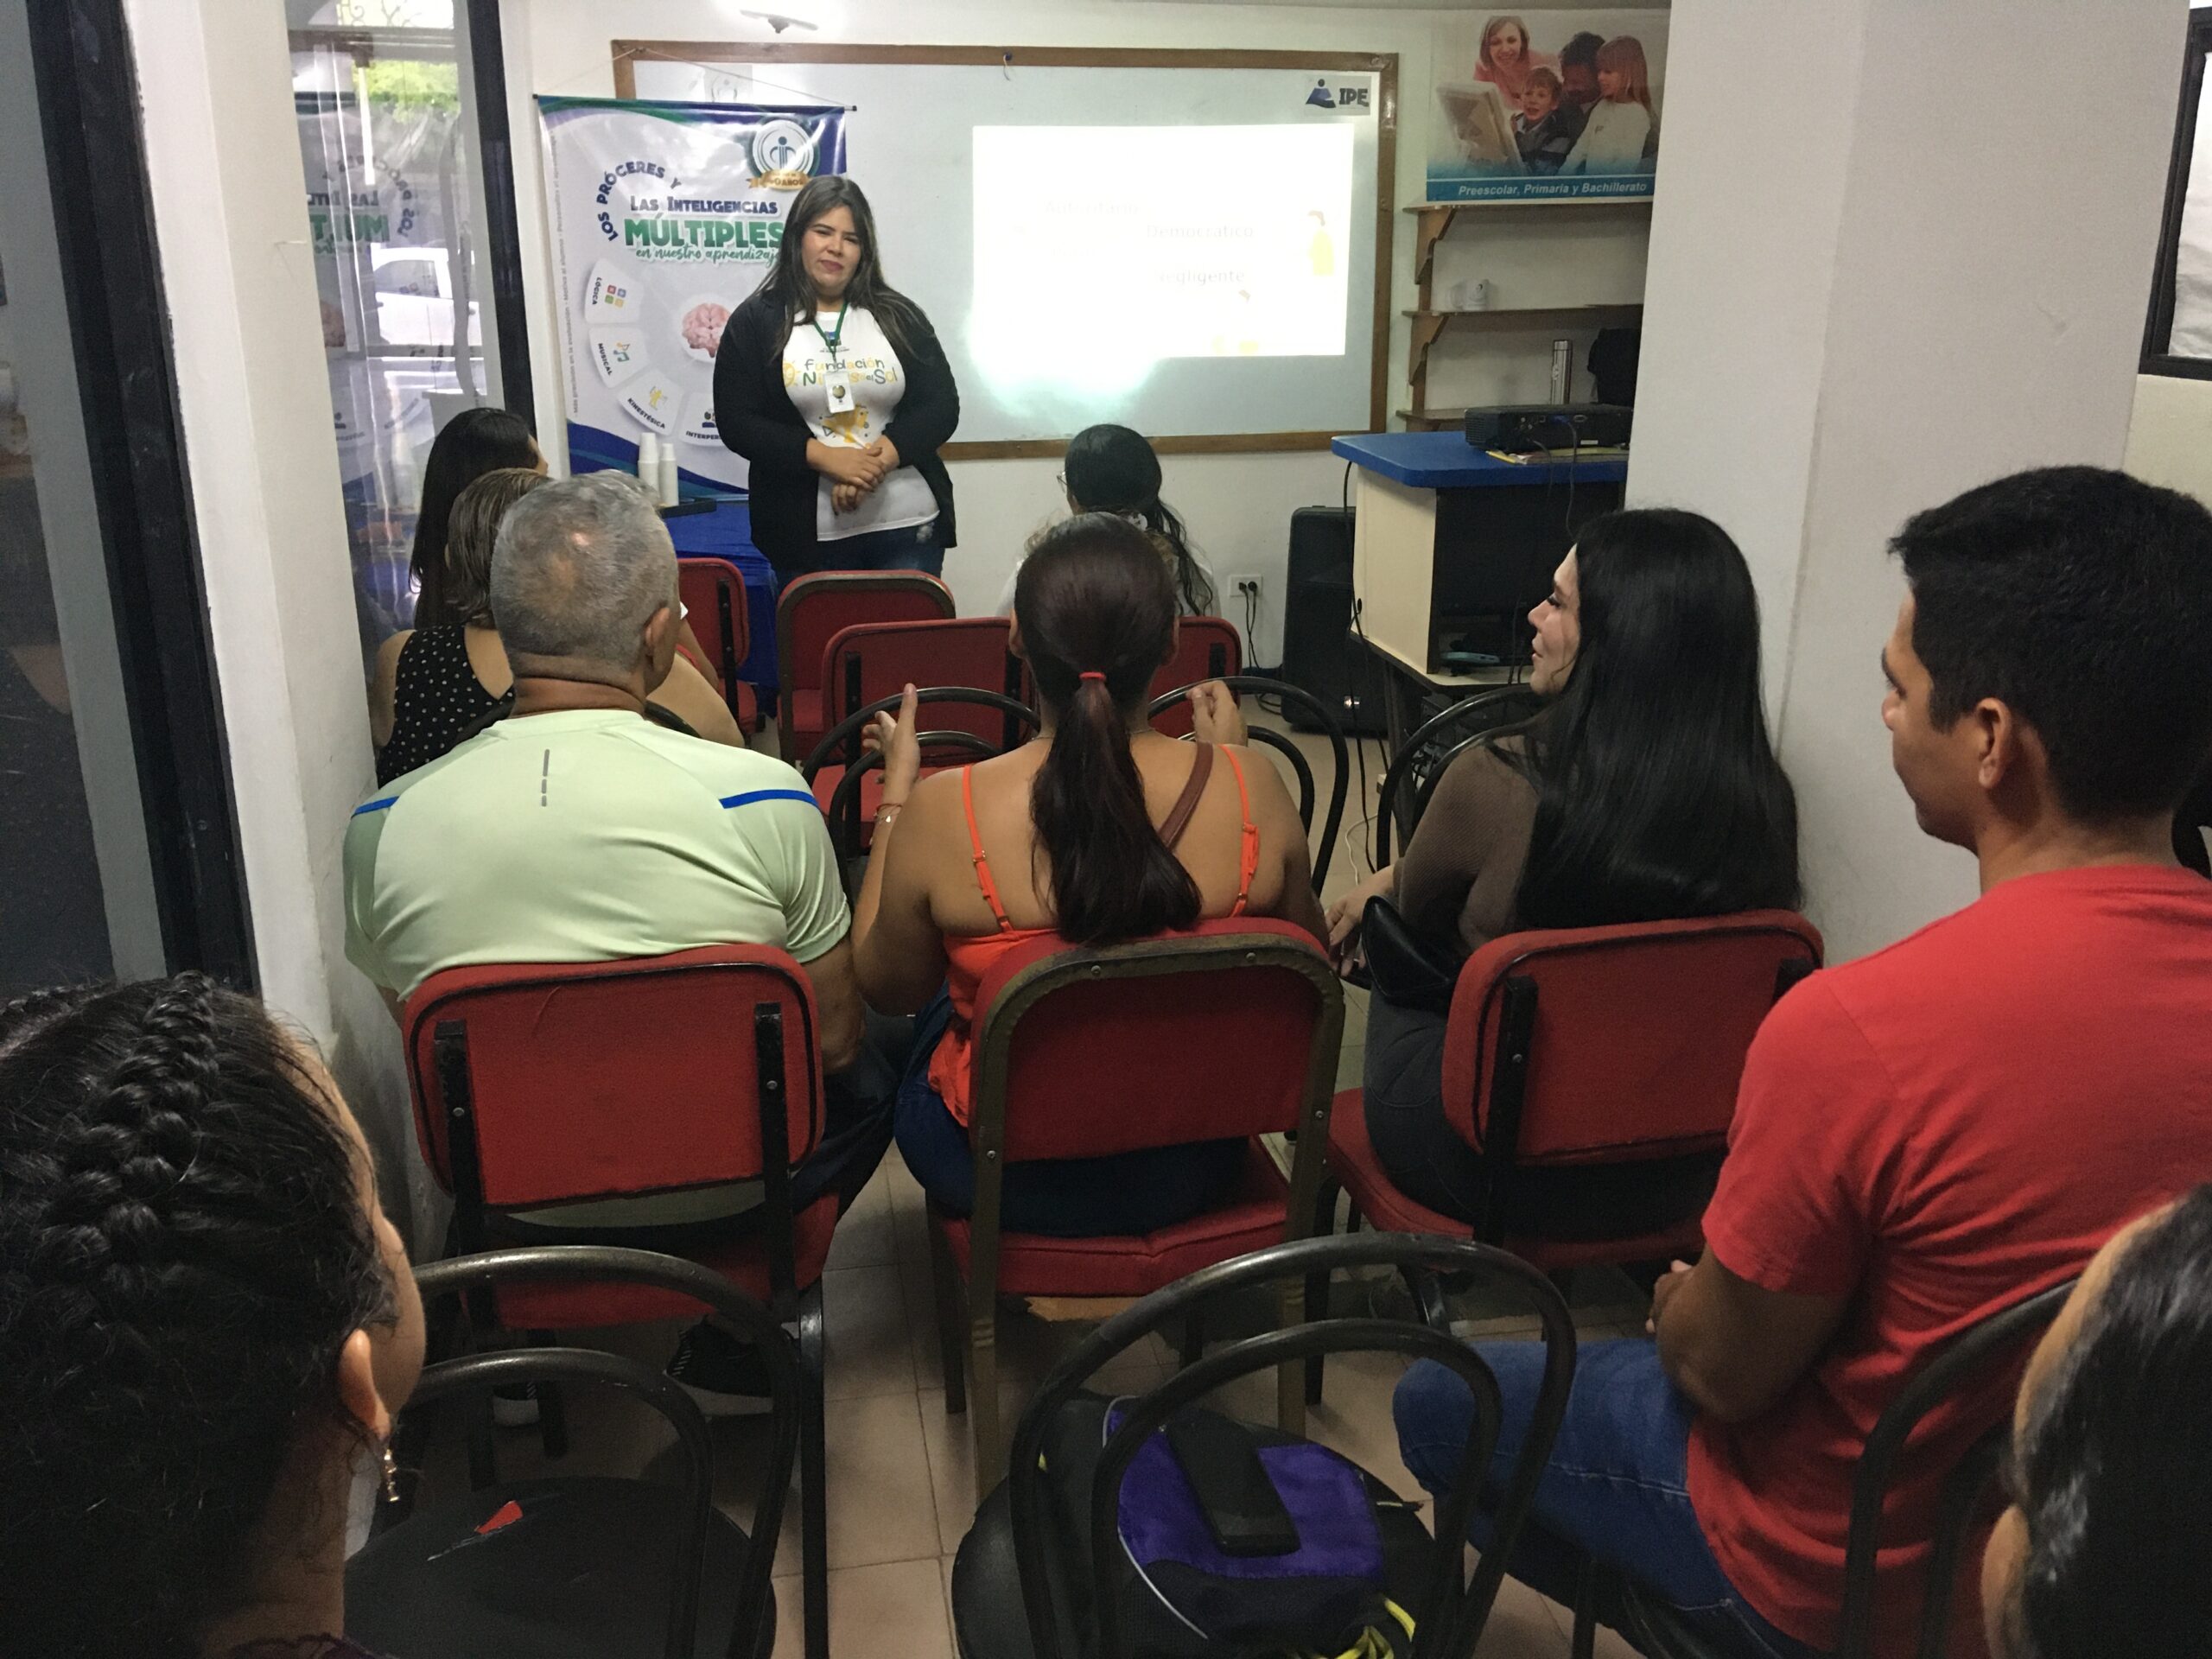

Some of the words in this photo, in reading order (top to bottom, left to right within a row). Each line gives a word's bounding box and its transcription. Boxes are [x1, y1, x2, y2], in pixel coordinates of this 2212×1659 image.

[1339, 87, 1370, 107] IPE
[596, 160, 666, 206] PRÓCERES
[670, 176, 683, 190] Y
[1458, 183, 1522, 196] Preescolar,
[1523, 182, 1570, 194] Primaria
[1571, 184, 1580, 196] y
[1580, 181, 1648, 194] Bachillerato
[597, 211, 620, 242] LOS
[624, 212, 784, 249] MÚLTIPLES
[636, 248, 652, 259] en
[654, 242, 702, 260] nuestro
[598, 342, 613, 376] MUSICAL
[874, 366, 899, 385] Sol
[627, 397, 665, 429] KINESTÉSICA
